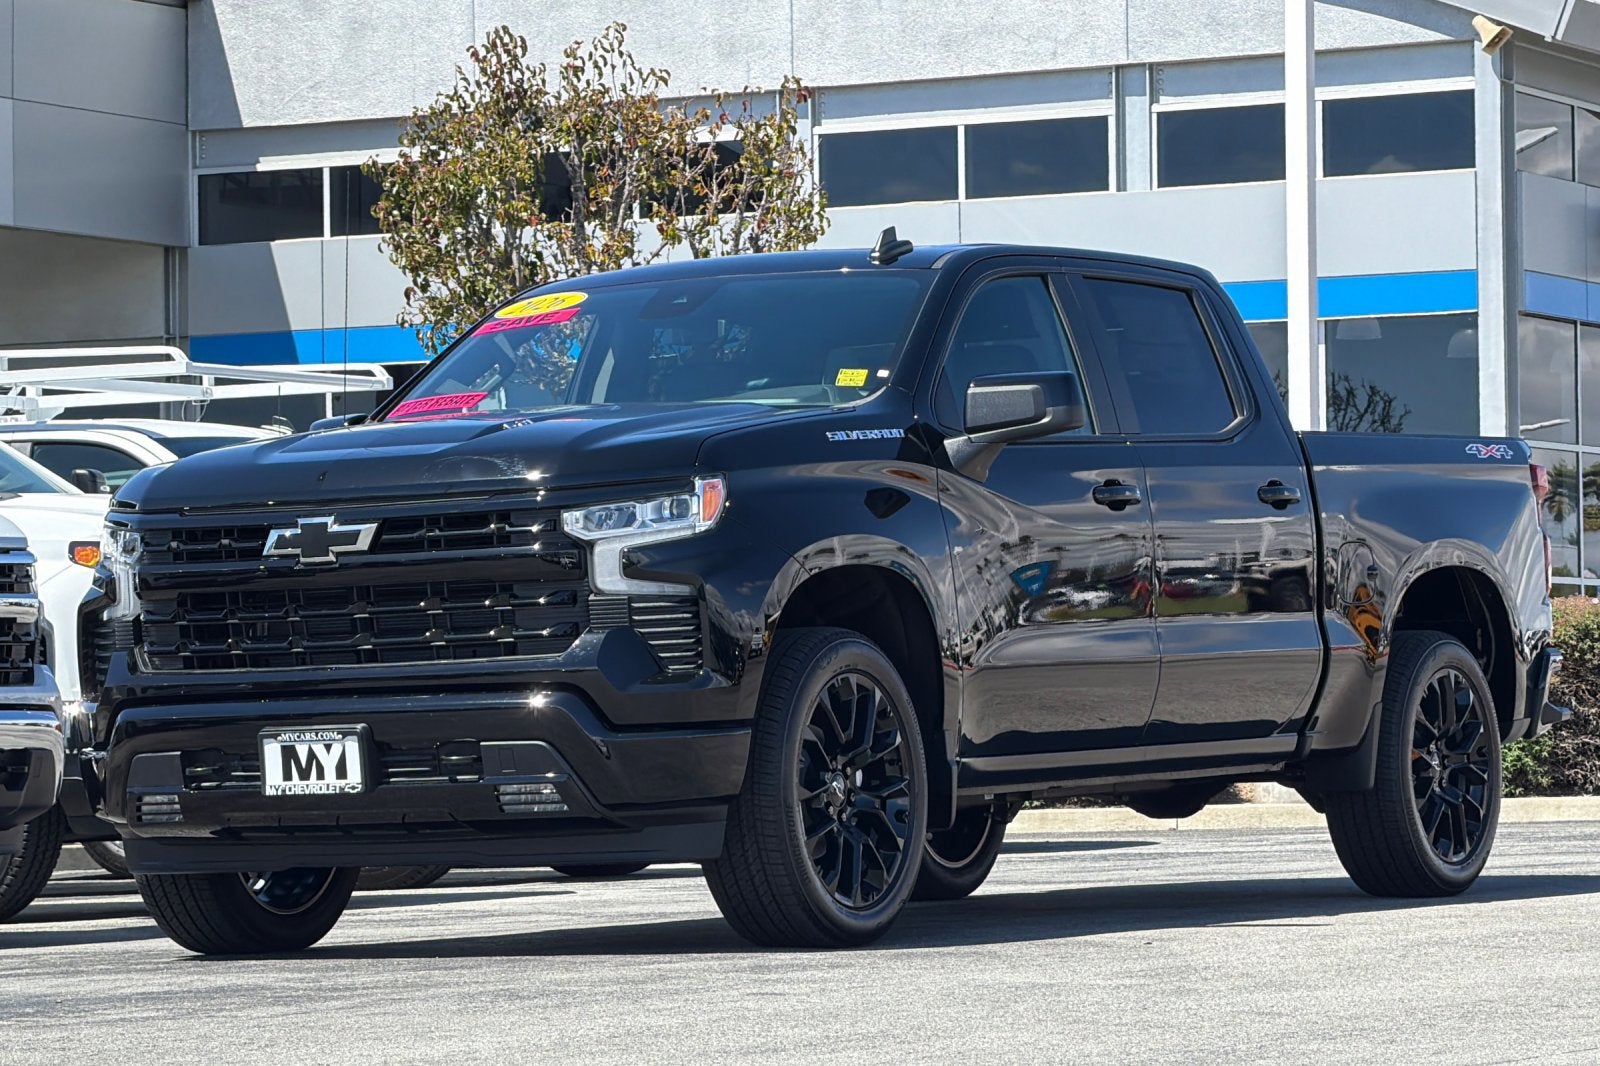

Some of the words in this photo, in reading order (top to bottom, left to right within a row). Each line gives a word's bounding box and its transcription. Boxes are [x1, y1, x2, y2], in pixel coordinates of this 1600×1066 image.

[490, 311, 560, 330] SAVE
[825, 428, 905, 442] SILVERADO
[280, 731, 338, 742] MYCARS.COM
[280, 742, 349, 783] MY
[285, 782, 342, 795] CHEVROLET
